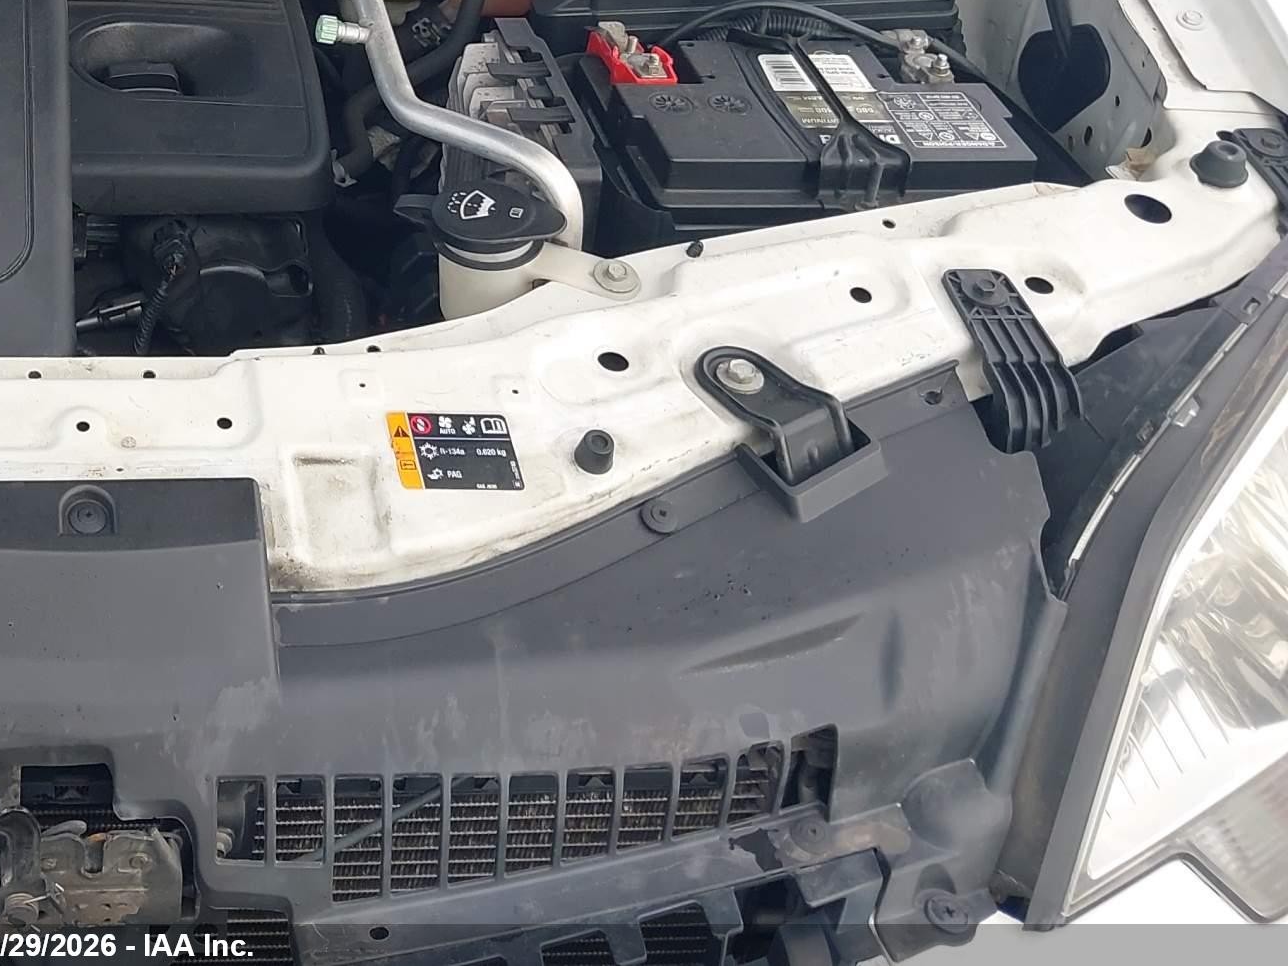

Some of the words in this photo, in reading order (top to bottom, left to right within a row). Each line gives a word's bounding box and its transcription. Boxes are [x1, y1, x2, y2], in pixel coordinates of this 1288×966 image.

[439, 427, 456, 435] AUTO
[439, 447, 466, 456] R-134a
[497, 447, 508, 458] kg
